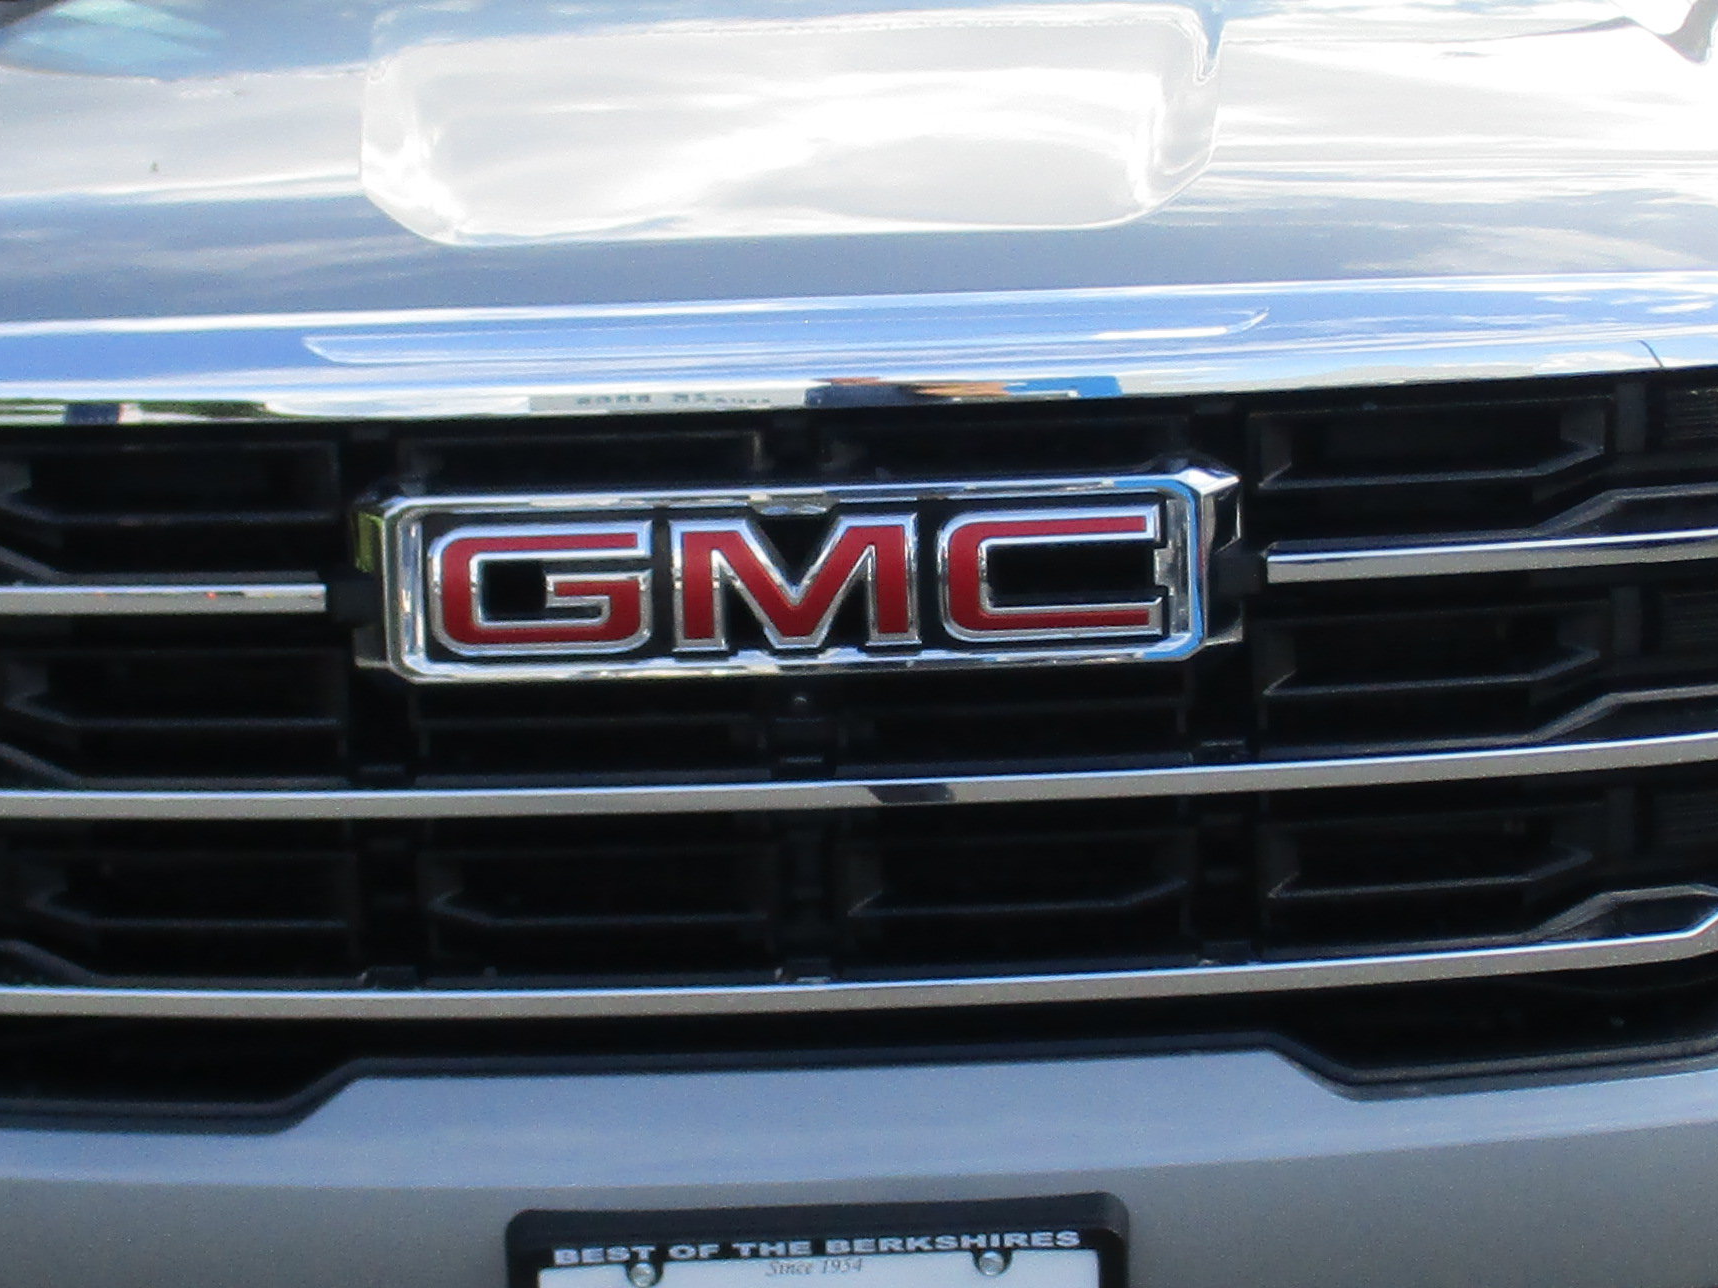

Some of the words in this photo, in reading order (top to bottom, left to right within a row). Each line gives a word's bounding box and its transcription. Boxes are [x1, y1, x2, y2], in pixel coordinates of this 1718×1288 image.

[428, 504, 1166, 657] GMC
[552, 1245, 657, 1266] BEST
[668, 1243, 721, 1261] OF
[731, 1240, 813, 1258] THE
[824, 1230, 1081, 1256] BERKSHIRES
